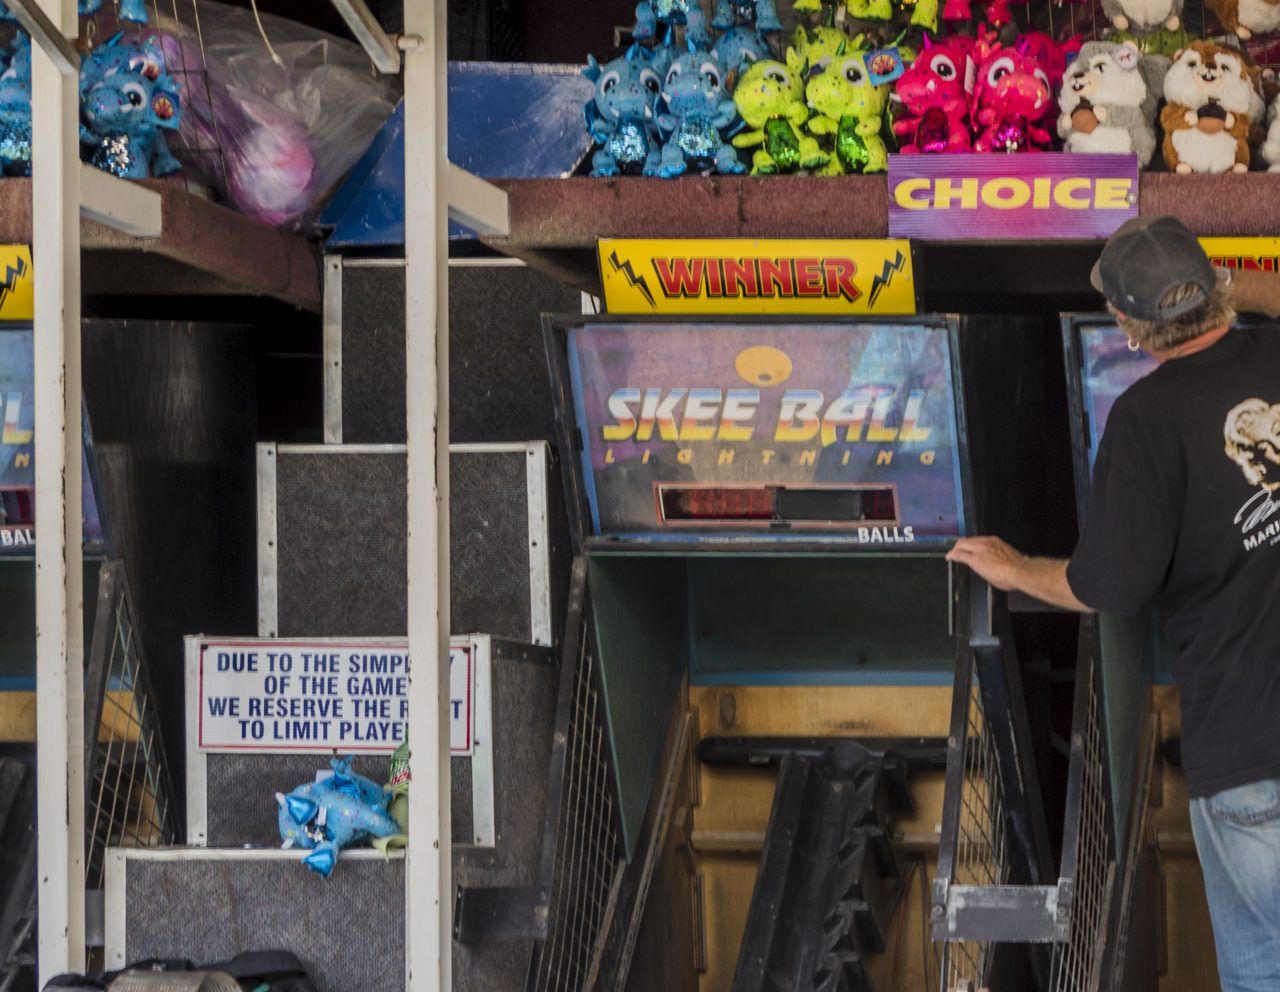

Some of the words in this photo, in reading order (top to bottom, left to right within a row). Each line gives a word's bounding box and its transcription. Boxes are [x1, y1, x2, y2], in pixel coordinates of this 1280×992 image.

[894, 177, 1132, 210] CHOICE
[651, 256, 863, 303] WINNER
[603, 388, 760, 441] SKEE
[774, 388, 933, 447] BALL
[604, 448, 936, 466] LIGHTNING
[1, 529, 36, 546] BAL
[858, 527, 915, 543] BALLS
[217, 653, 258, 673] DUE
[266, 654, 292, 673] TO
[300, 654, 340, 673] THE
[264, 676, 290, 695] OF
[299, 676, 338, 695] THE
[347, 677, 407, 696] GAME
[208, 698, 240, 717] WE
[249, 698, 343, 718] RESERVE
[352, 699, 390, 718] THE
[238, 720, 264, 739] TO
[274, 721, 331, 740] LIMIT
[340, 722, 408, 741] PLAYE
